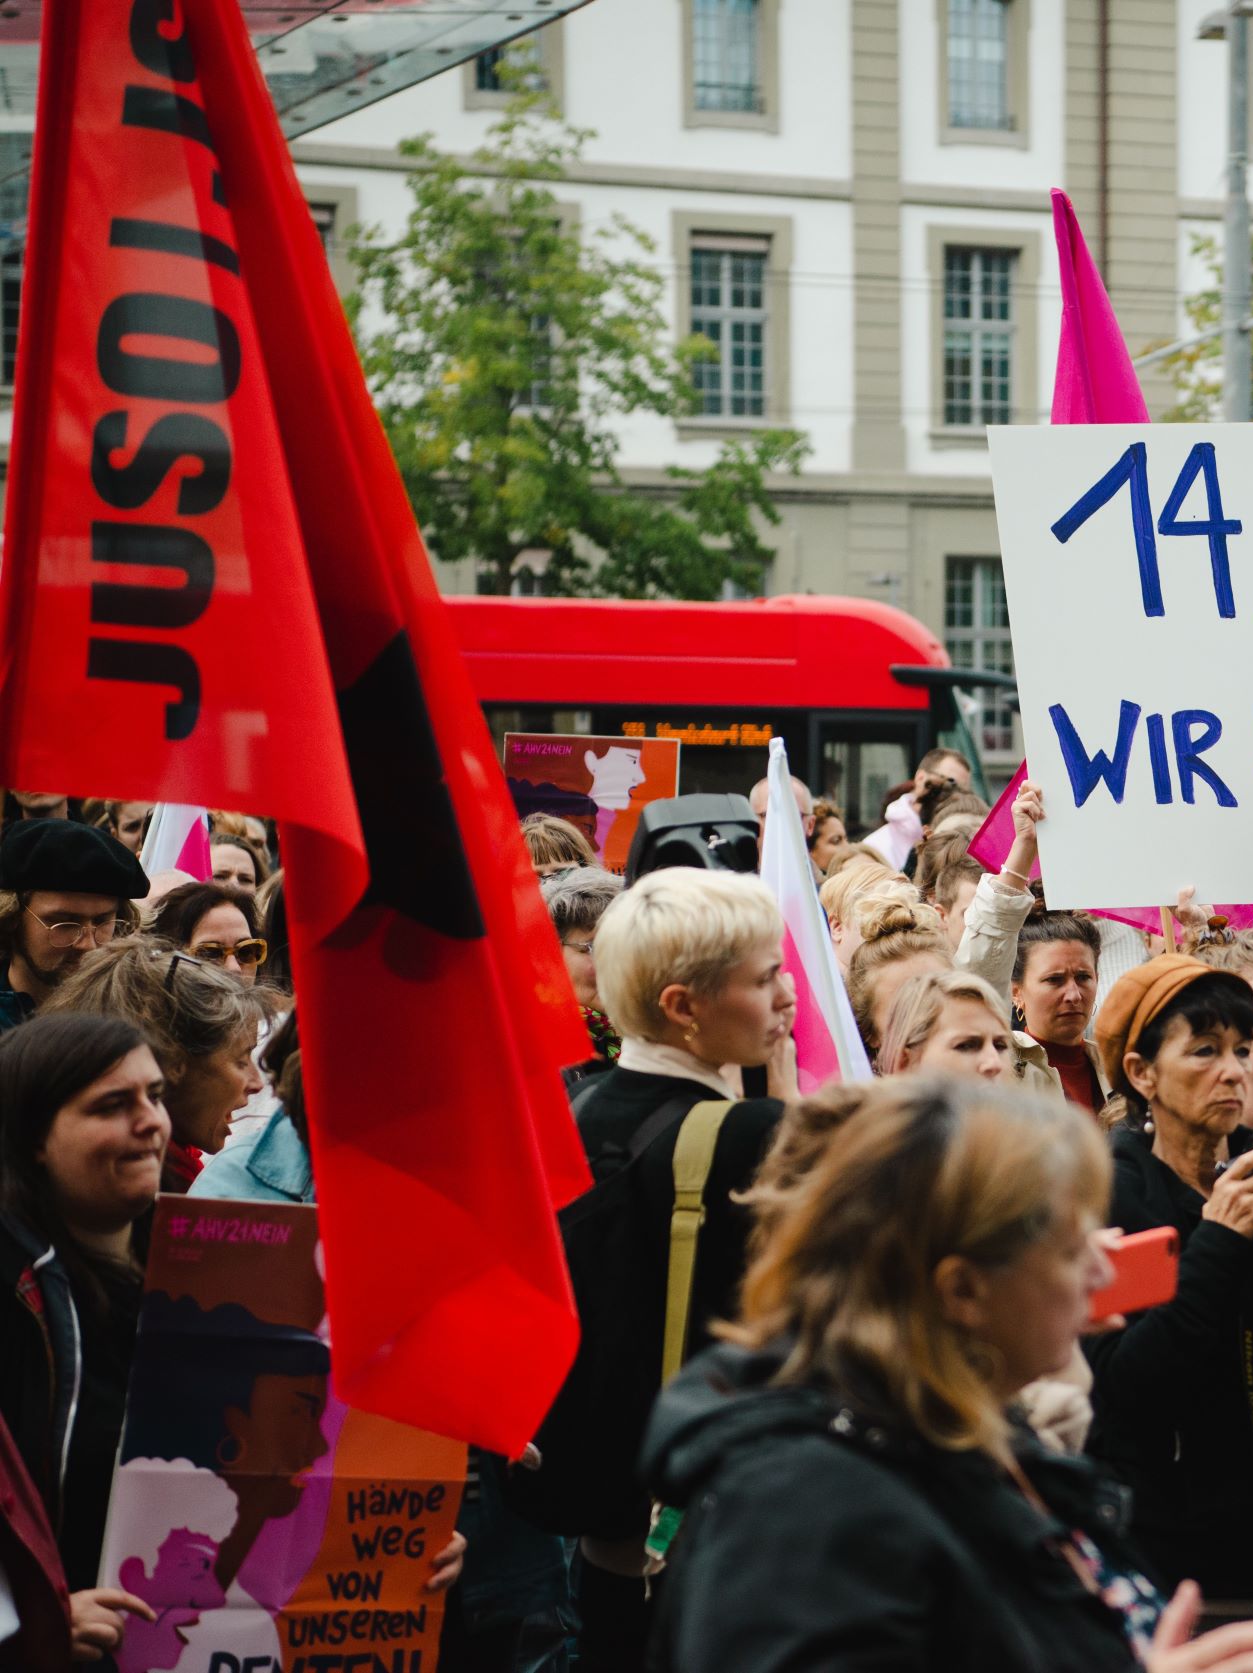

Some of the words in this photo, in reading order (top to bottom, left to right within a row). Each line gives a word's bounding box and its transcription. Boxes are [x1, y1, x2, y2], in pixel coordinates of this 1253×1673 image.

[87, 291, 241, 741] JUSO
[1048, 699, 1239, 808] WIR
[326, 1570, 383, 1602] VON
